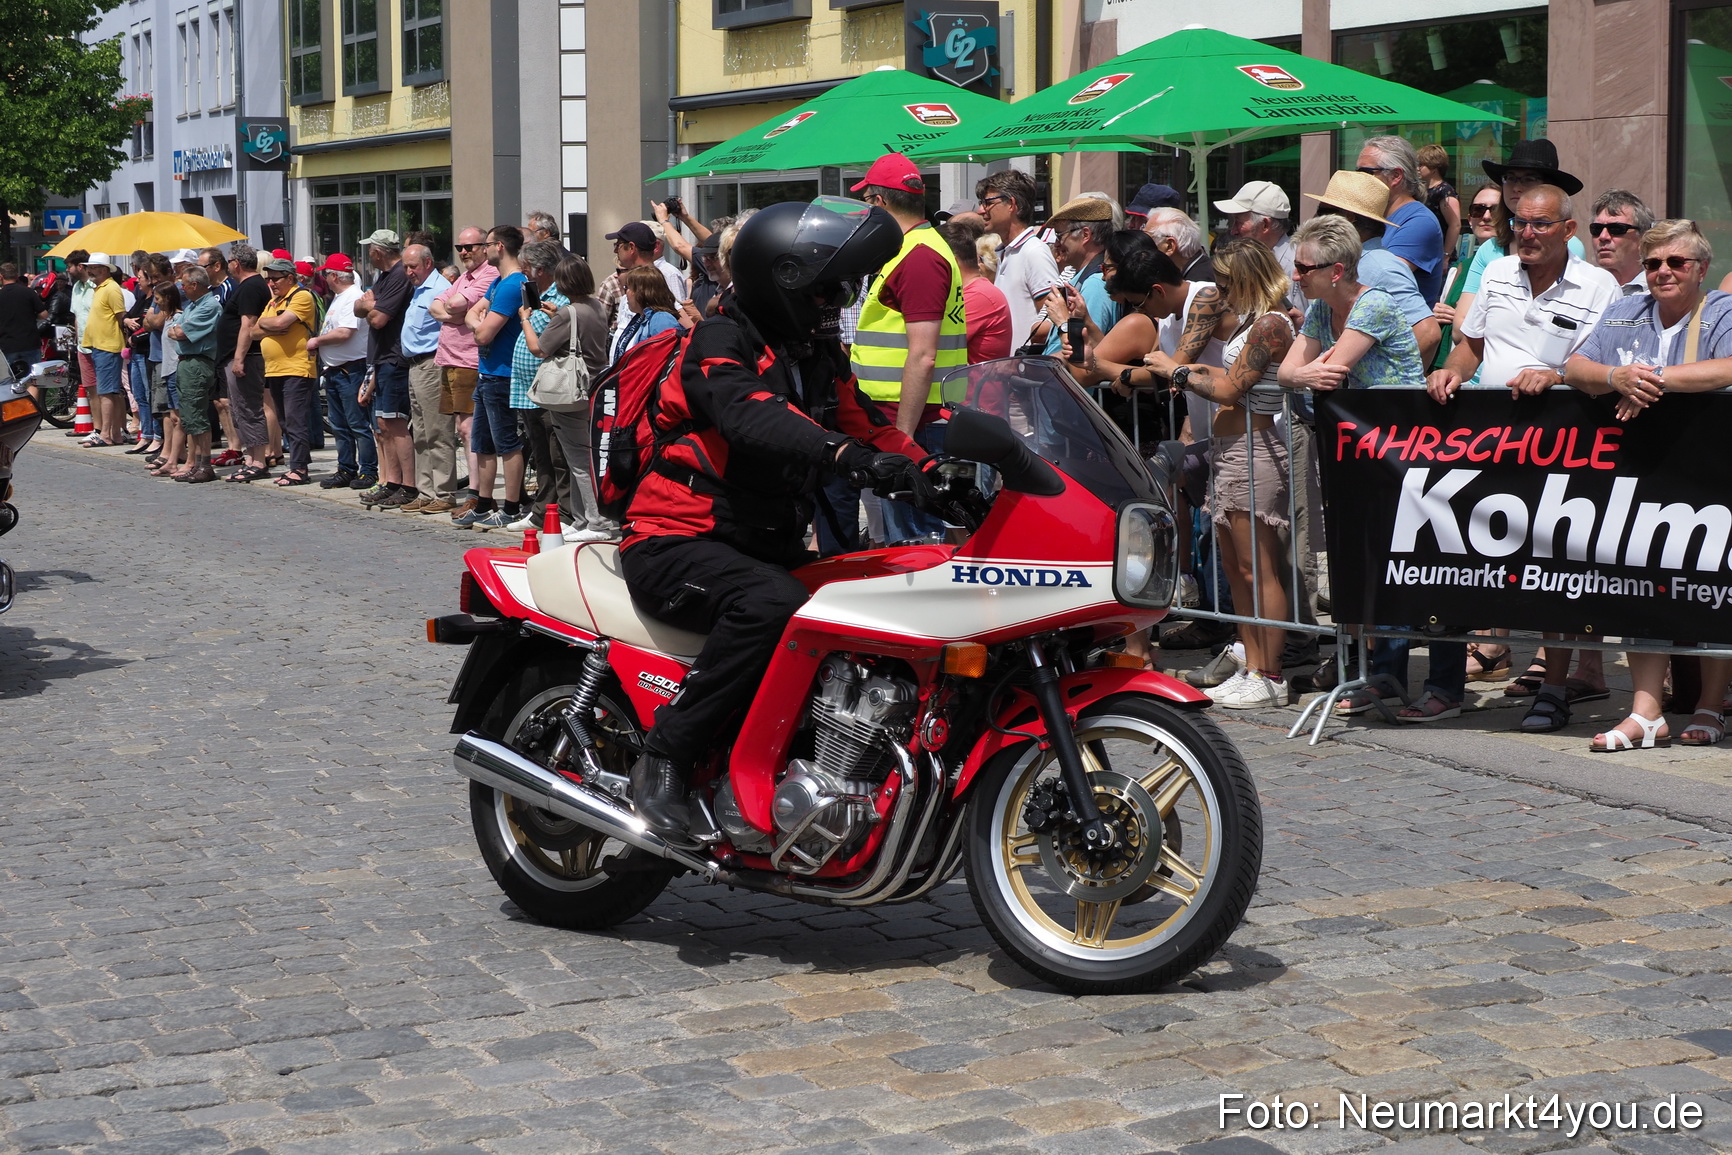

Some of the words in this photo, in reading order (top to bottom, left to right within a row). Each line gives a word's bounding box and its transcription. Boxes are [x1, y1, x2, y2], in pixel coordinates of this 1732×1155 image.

[945, 28, 977, 69] G2
[1243, 103, 1399, 119] Lammsbräu
[1251, 94, 1359, 106] Neumarkter
[1021, 107, 1105, 123] Neumarkter
[983, 117, 1100, 139] Lammsbräu
[256, 131, 275, 154] G2
[1336, 421, 1623, 470] FAHRSCHULE
[1390, 467, 1732, 573] Kohlm
[952, 565, 1092, 587] HONDA
[1385, 559, 1507, 589] Neumarkt
[1521, 565, 1654, 599] Burgthann
[637, 680, 654, 692] BOL
